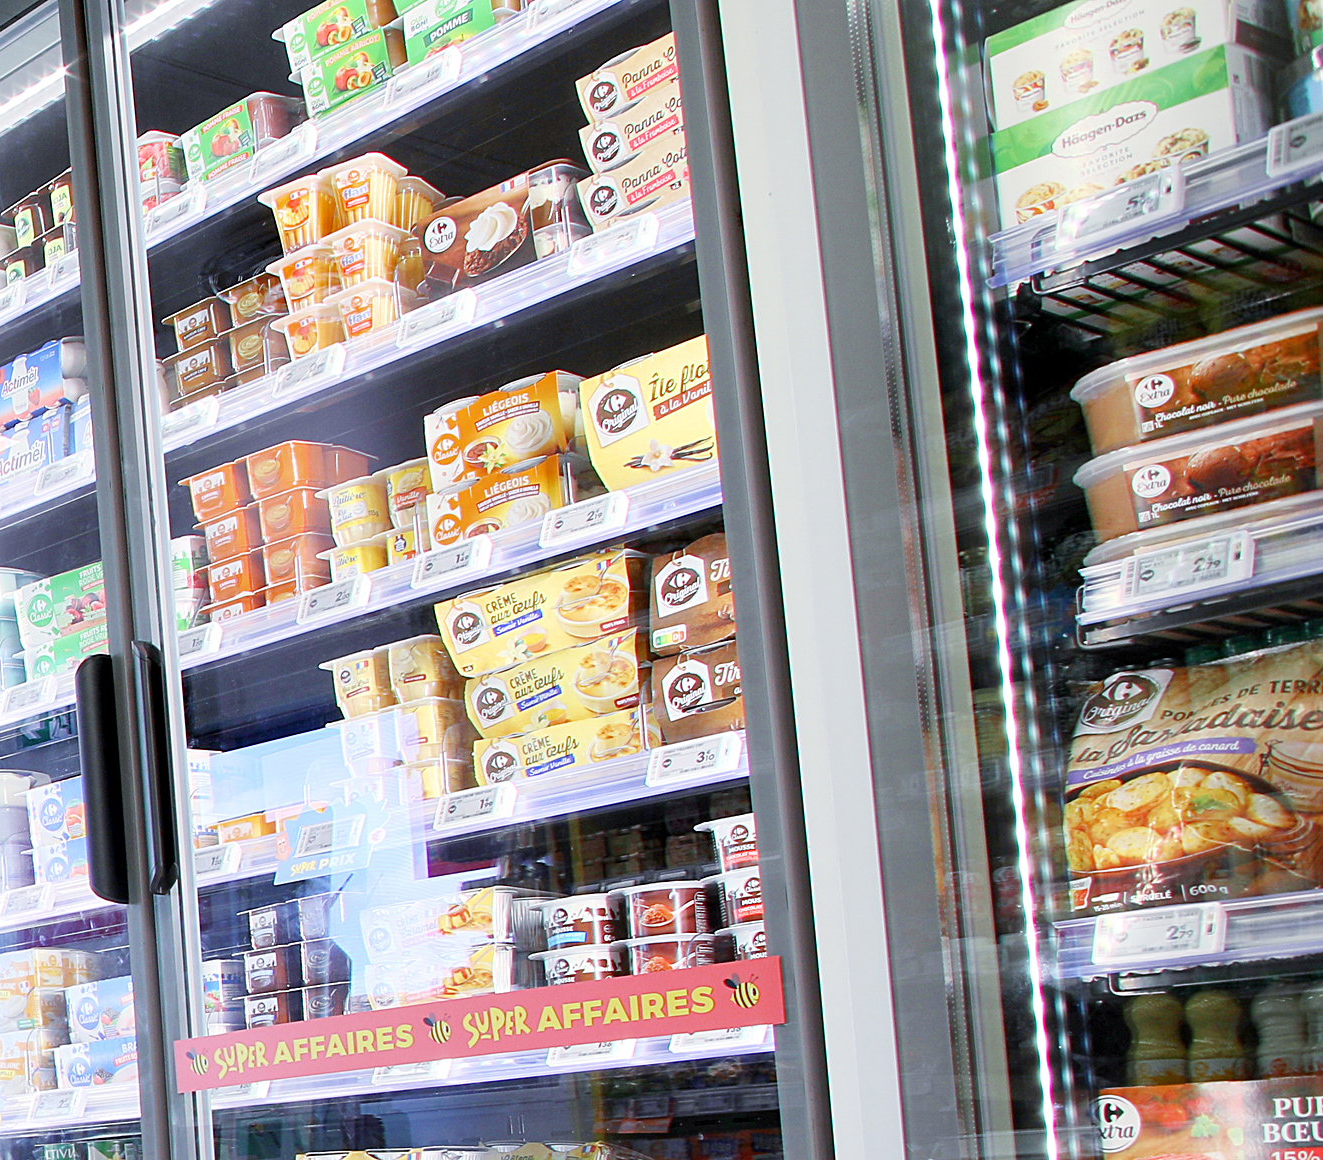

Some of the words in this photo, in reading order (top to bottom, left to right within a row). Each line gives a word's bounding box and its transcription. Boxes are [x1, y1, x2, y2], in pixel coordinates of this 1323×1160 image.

[429, 11, 470, 43] POMME
[621, 58, 662, 88] Panna
[202, 116, 222, 133] POMME
[223, 105, 242, 123] FRAISE
[624, 109, 664, 139] Panna
[1061, 110, 1147, 149] Häagen-Dazs
[208, 164, 228, 180] POMME
[228, 154, 247, 169] FRAISE
[621, 164, 662, 193] Panna
[341, 182, 369, 200] flan
[428, 230, 455, 250] Extra
[0, 365, 40, 396] Actimel
[648, 372, 677, 404] Île
[482, 392, 530, 418] LIÉGEOIS
[668, 400, 682, 412] la
[1140, 388, 1171, 403] Extra
[1155, 406, 1195, 423] Chocolat
[1196, 401, 1216, 413] noir
[1222, 392, 1246, 405] Pure
[1247, 379, 1297, 399] chocolade
[601, 398, 639, 432] Original
[483, 474, 530, 499] LIÉGEOIS
[1137, 478, 1167, 493] Extra
[1151, 496, 1192, 513] Chocolat
[1192, 492, 1212, 503] noir
[1217, 483, 1241, 496] Pure
[1242, 474, 1291, 492] chocolade
[486, 593, 516, 613] CRÈME
[663, 578, 701, 605] Original
[490, 610, 511, 624] aux
[512, 590, 547, 615] œufs
[510, 668, 538, 689] CRÈME
[514, 685, 534, 699] aux
[534, 667, 565, 694] œufs
[1239, 683, 1259, 698] DE
[1270, 679, 1323, 694] TERR
[672, 683, 706, 710] Original
[1085, 695, 1154, 722] Original
[522, 735, 552, 755] CRÈME
[525, 752, 544, 765] aux
[546, 735, 580, 758] œufs
[1083, 764, 1126, 780] Cuisinées
[1135, 754, 1145, 766] la
[1146, 746, 1181, 766] graisse
[1182, 743, 1197, 753] de
[1199, 740, 1240, 751] canard
[289, 860, 317, 876] SUPER
[318, 852, 356, 871] PRIX
[1189, 884, 1217, 896] 600
[462, 1006, 532, 1048] SUPER
[537, 986, 716, 1033] AFFAIRES
[213, 1041, 268, 1074] SUPER
[273, 1024, 414, 1067] AFFAIRES
